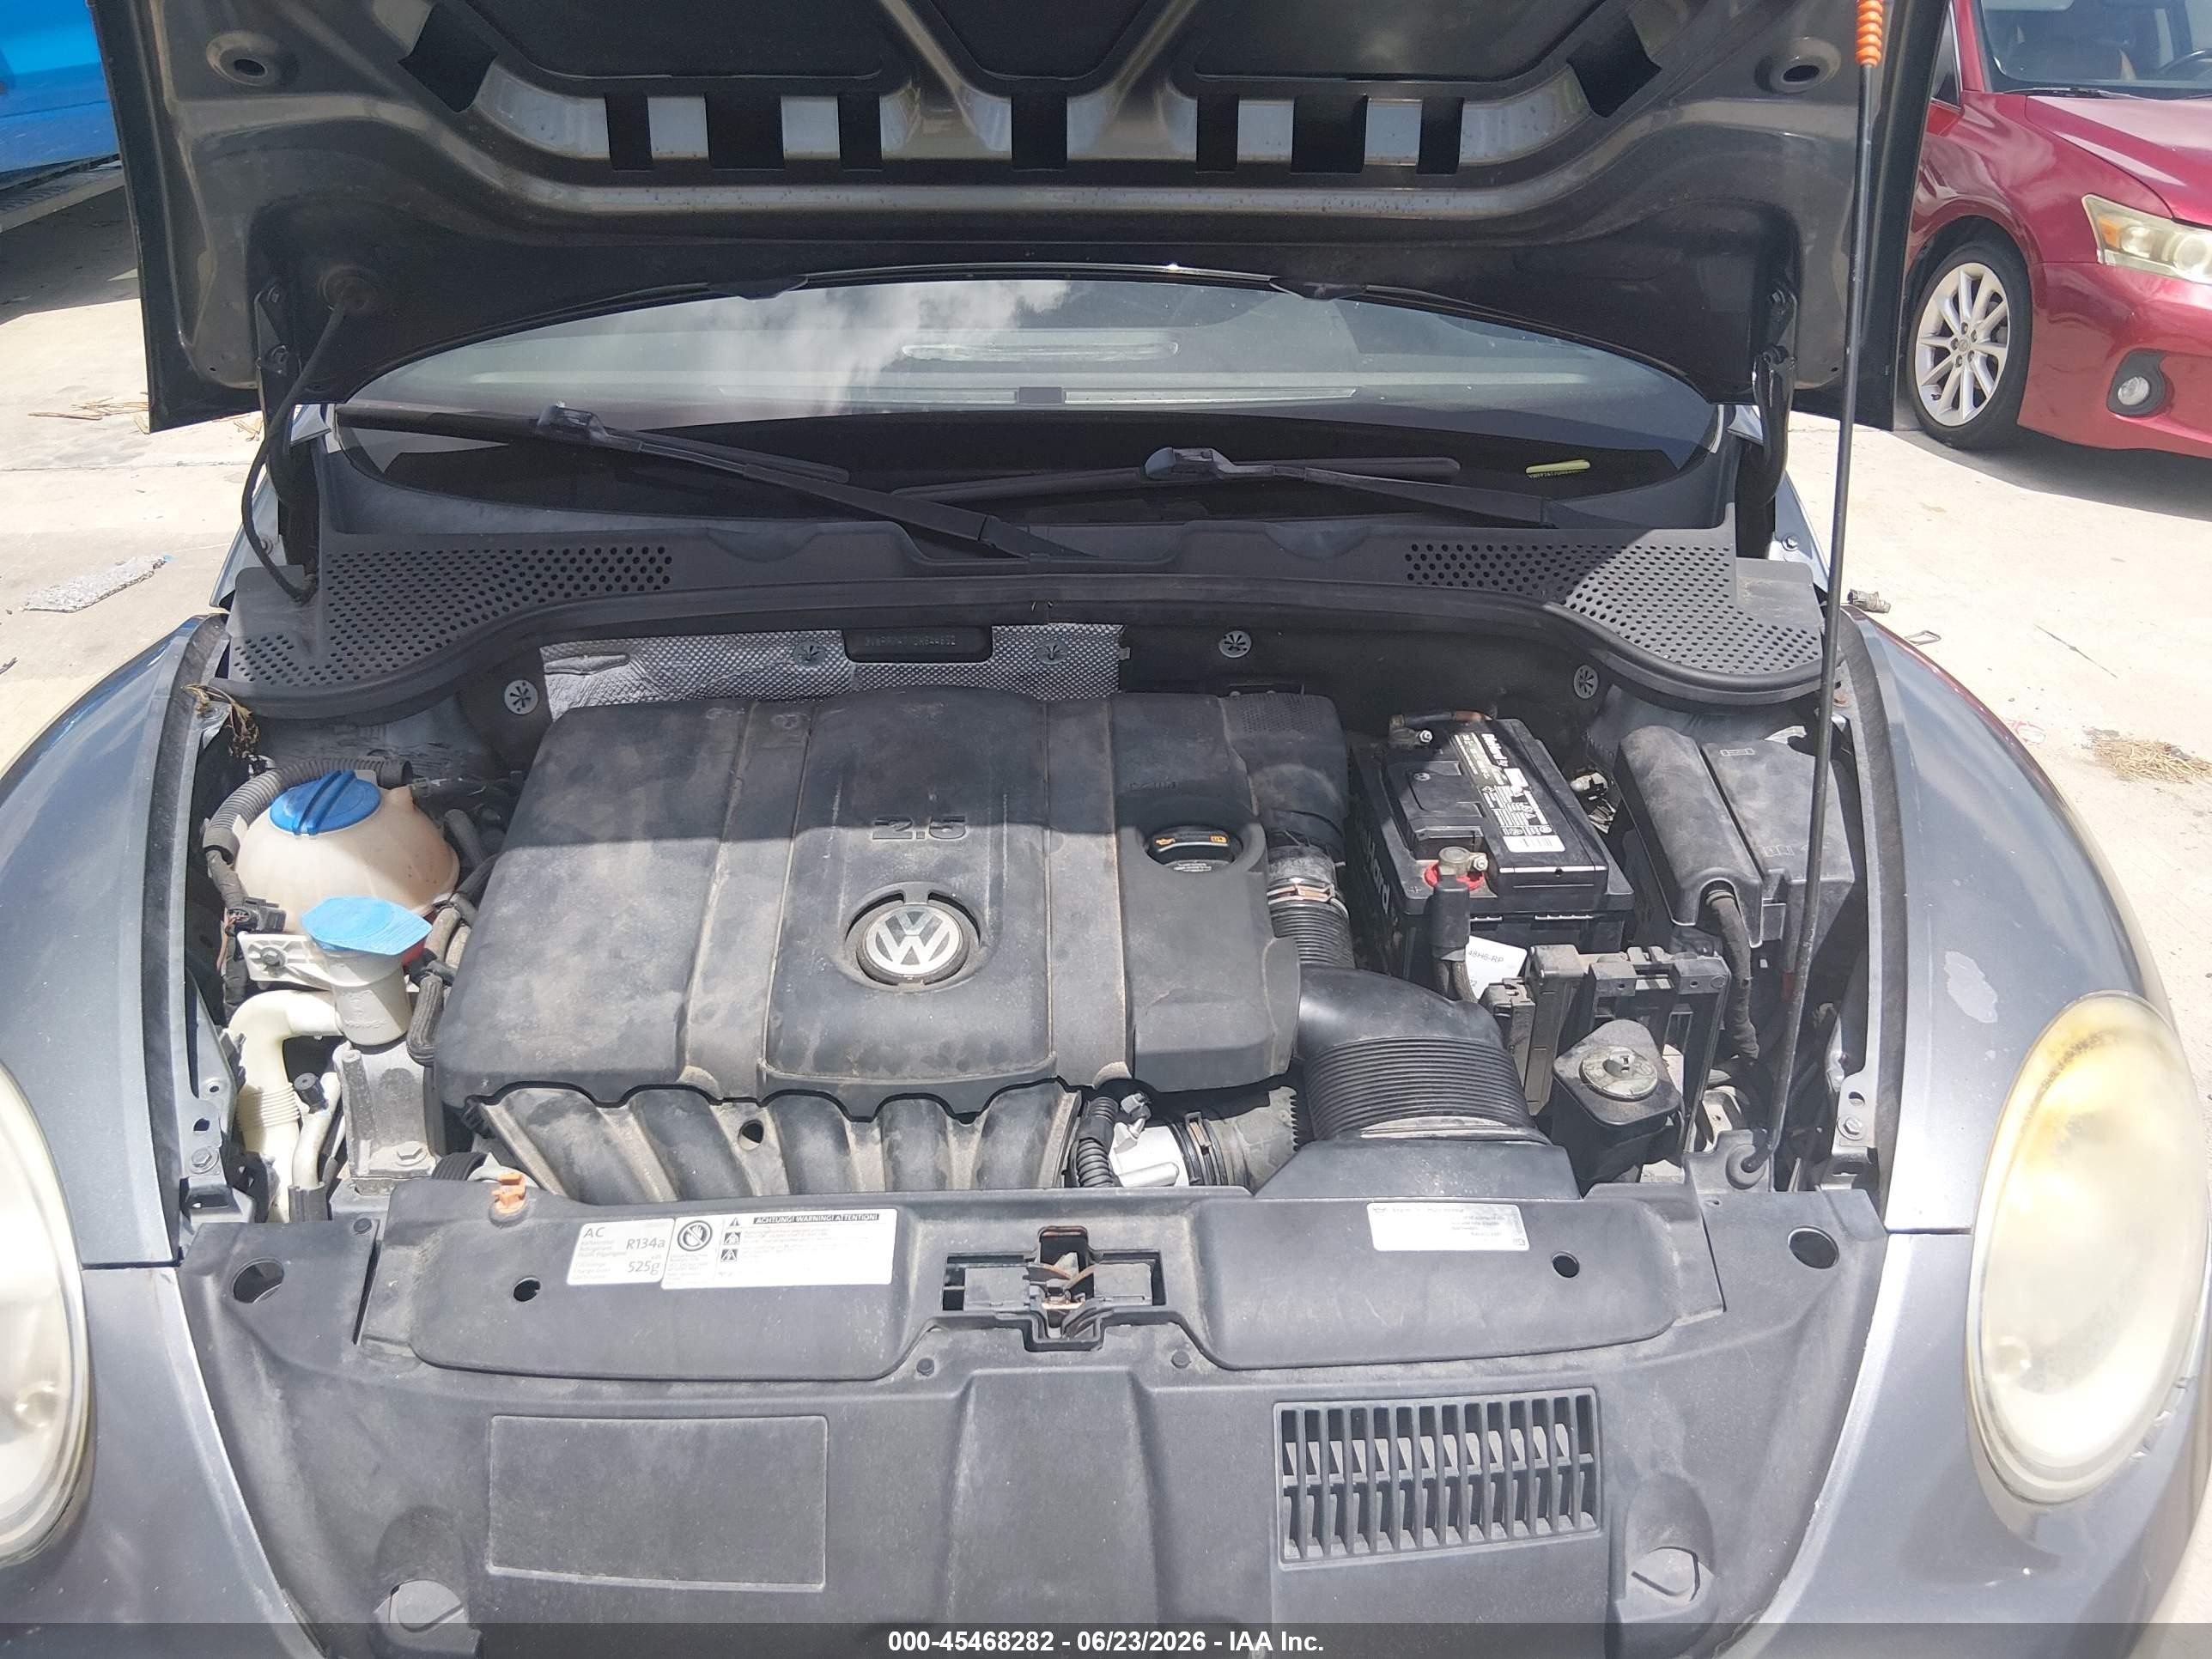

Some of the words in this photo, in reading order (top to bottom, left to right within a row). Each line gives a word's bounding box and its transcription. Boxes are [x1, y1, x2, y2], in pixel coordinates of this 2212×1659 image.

[872, 815, 967, 840] 2.5
[866, 904, 961, 975] VW
[756, 1215, 795, 1224] ACHTUNG!
[796, 1214, 835, 1223] WARNING!
[836, 1212, 878, 1222] ATTENTION!
[584, 1226, 605, 1237] AC
[626, 1237, 665, 1250] R134a
[628, 1261, 660, 1275] 525g
